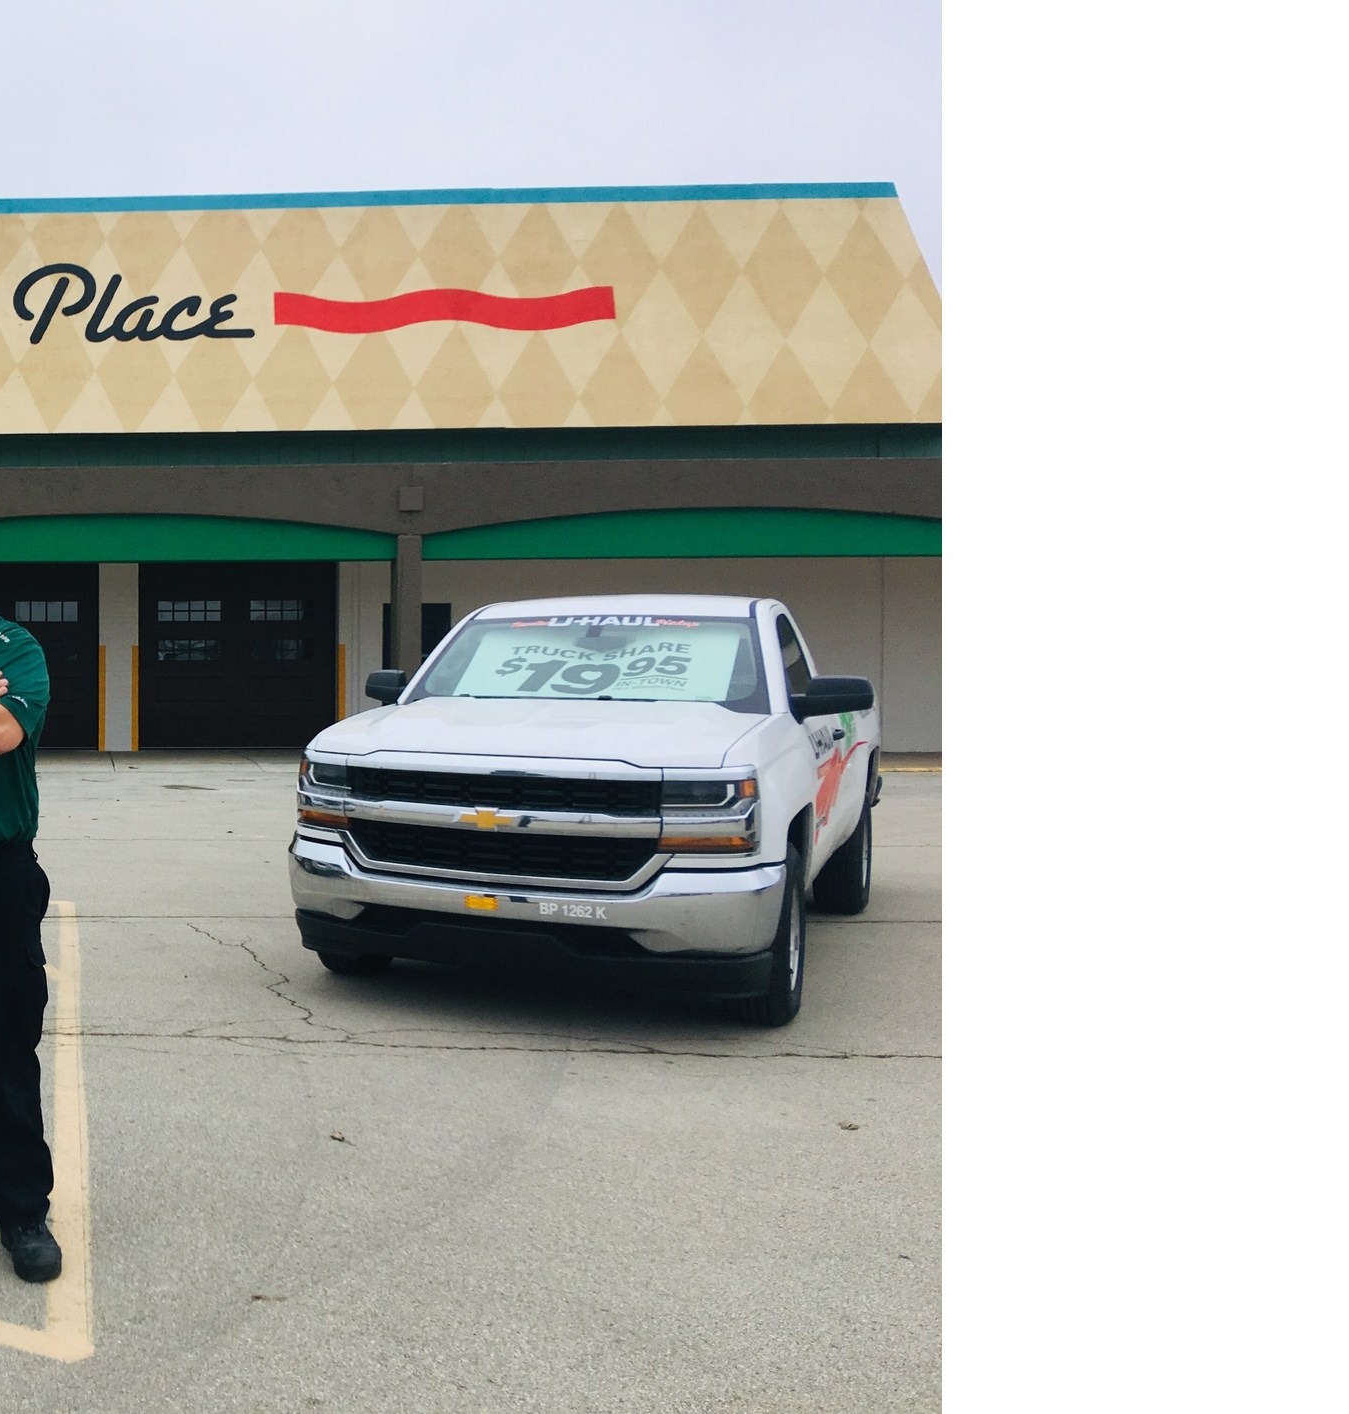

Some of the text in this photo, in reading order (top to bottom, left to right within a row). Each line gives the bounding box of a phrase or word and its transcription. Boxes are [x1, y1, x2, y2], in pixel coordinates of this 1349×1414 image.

[13, 263, 255, 344] Place
[547, 616, 660, 627] U-HAUL
[512, 642, 692, 661] TRUCK SHARE
[616, 677, 687, 688] IN-TOWN
[539, 902, 607, 919] BP 1262 K
